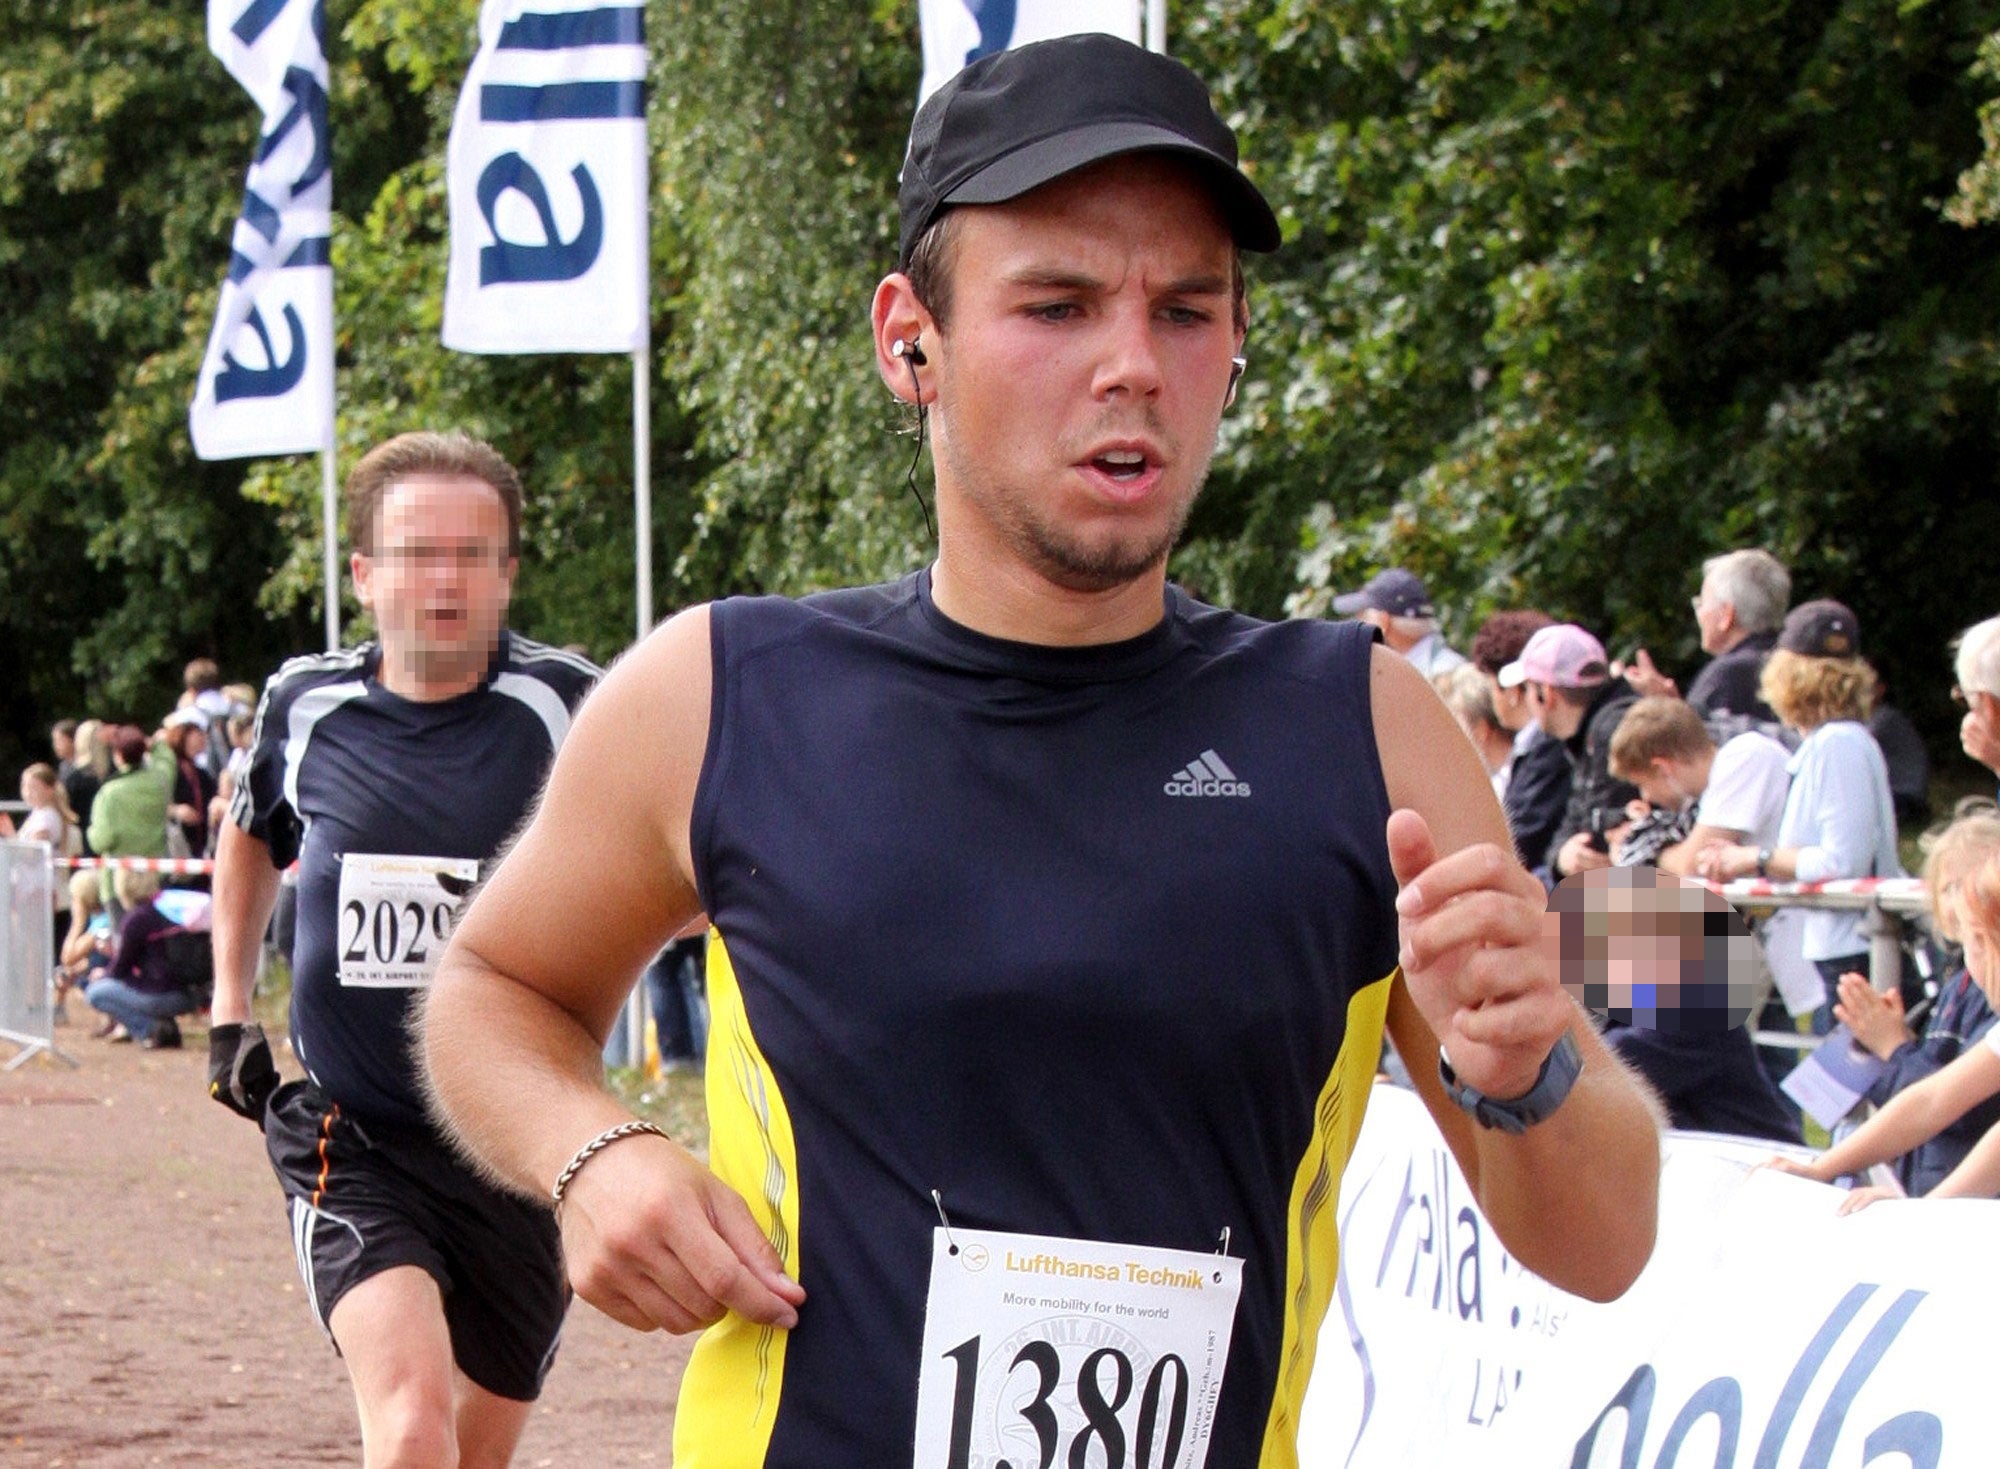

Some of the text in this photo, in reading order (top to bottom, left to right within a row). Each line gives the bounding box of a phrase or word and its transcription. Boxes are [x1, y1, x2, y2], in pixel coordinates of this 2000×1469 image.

[1163, 780, 1251, 797] adidas
[1005, 1251, 1204, 1289] Lufthansa Technik
[1003, 1292, 1169, 1320] More mobility for the world
[941, 1335, 1189, 1469] 1380
